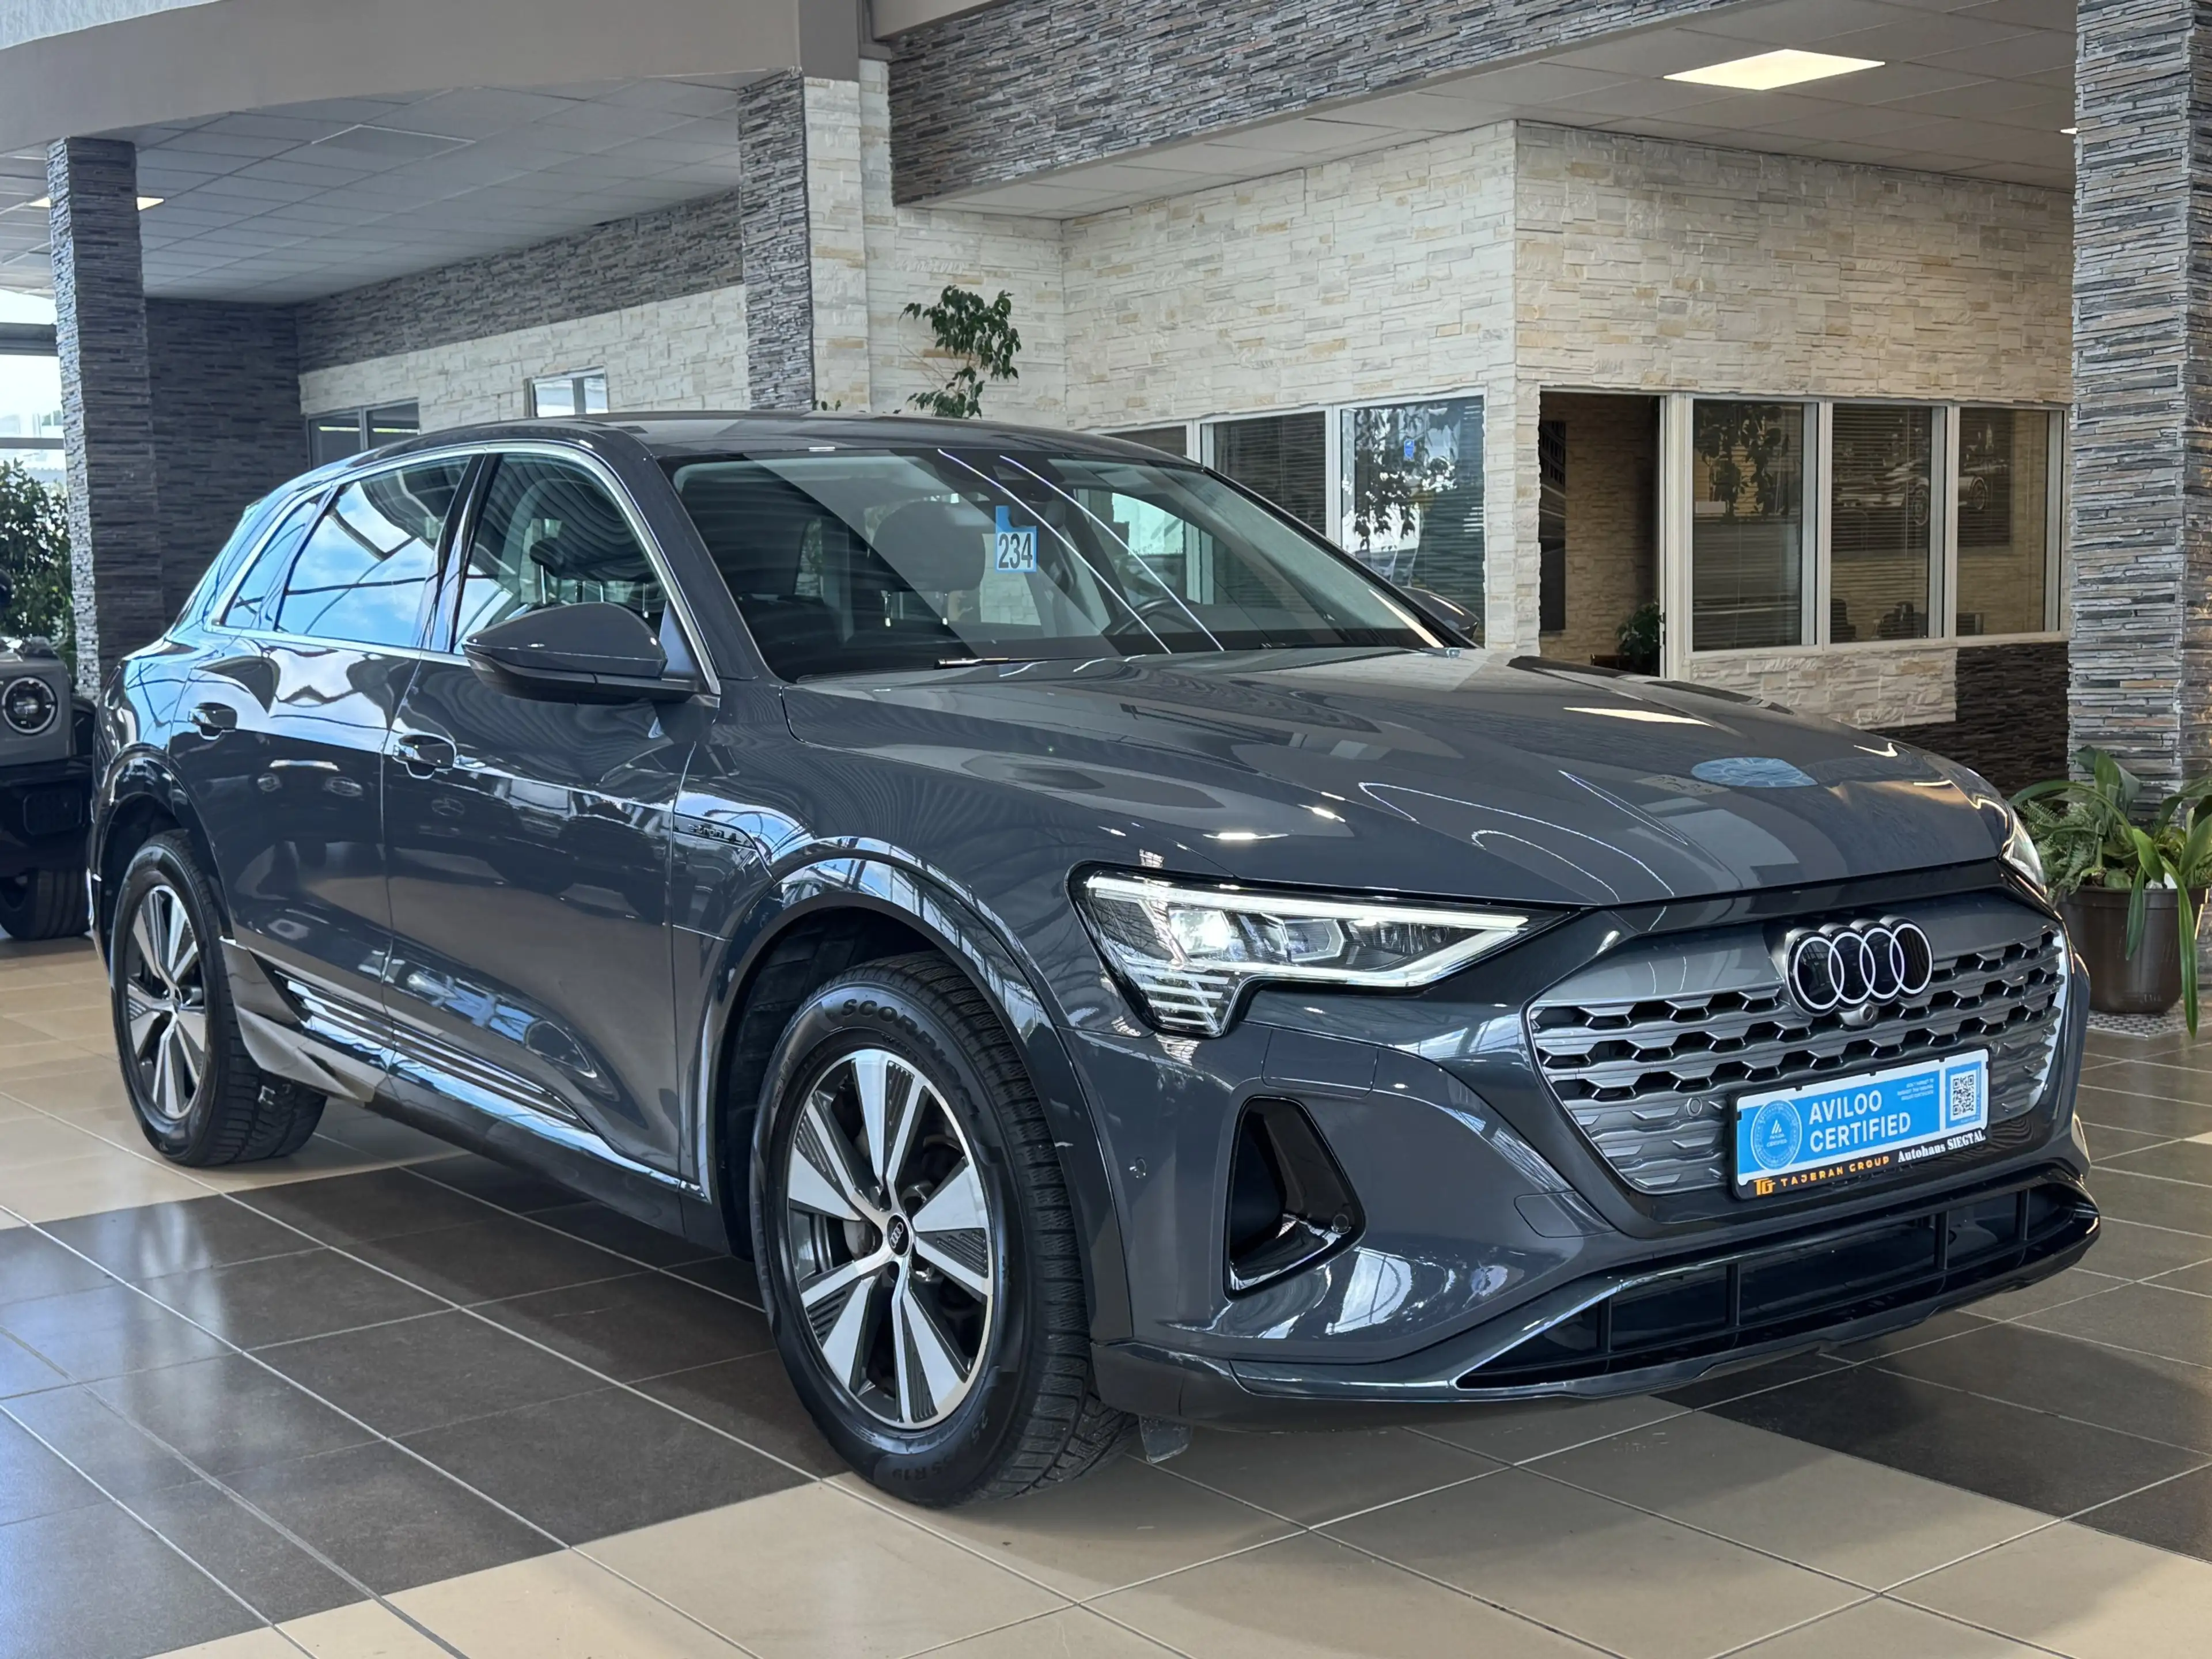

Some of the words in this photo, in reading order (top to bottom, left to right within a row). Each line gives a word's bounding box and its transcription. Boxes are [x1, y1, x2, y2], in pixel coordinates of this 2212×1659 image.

[998, 533, 1033, 569] 234
[1809, 1090, 1882, 1125] AVILOO
[1810, 1112, 1911, 1153] CERTIFIED
[1898, 1143, 1946, 1163] Autohaus
[1947, 1130, 1986, 1150] SIEGTAL
[1781, 1166, 1843, 1187] TAJERAN
[1849, 1156, 1890, 1173] GROUP
